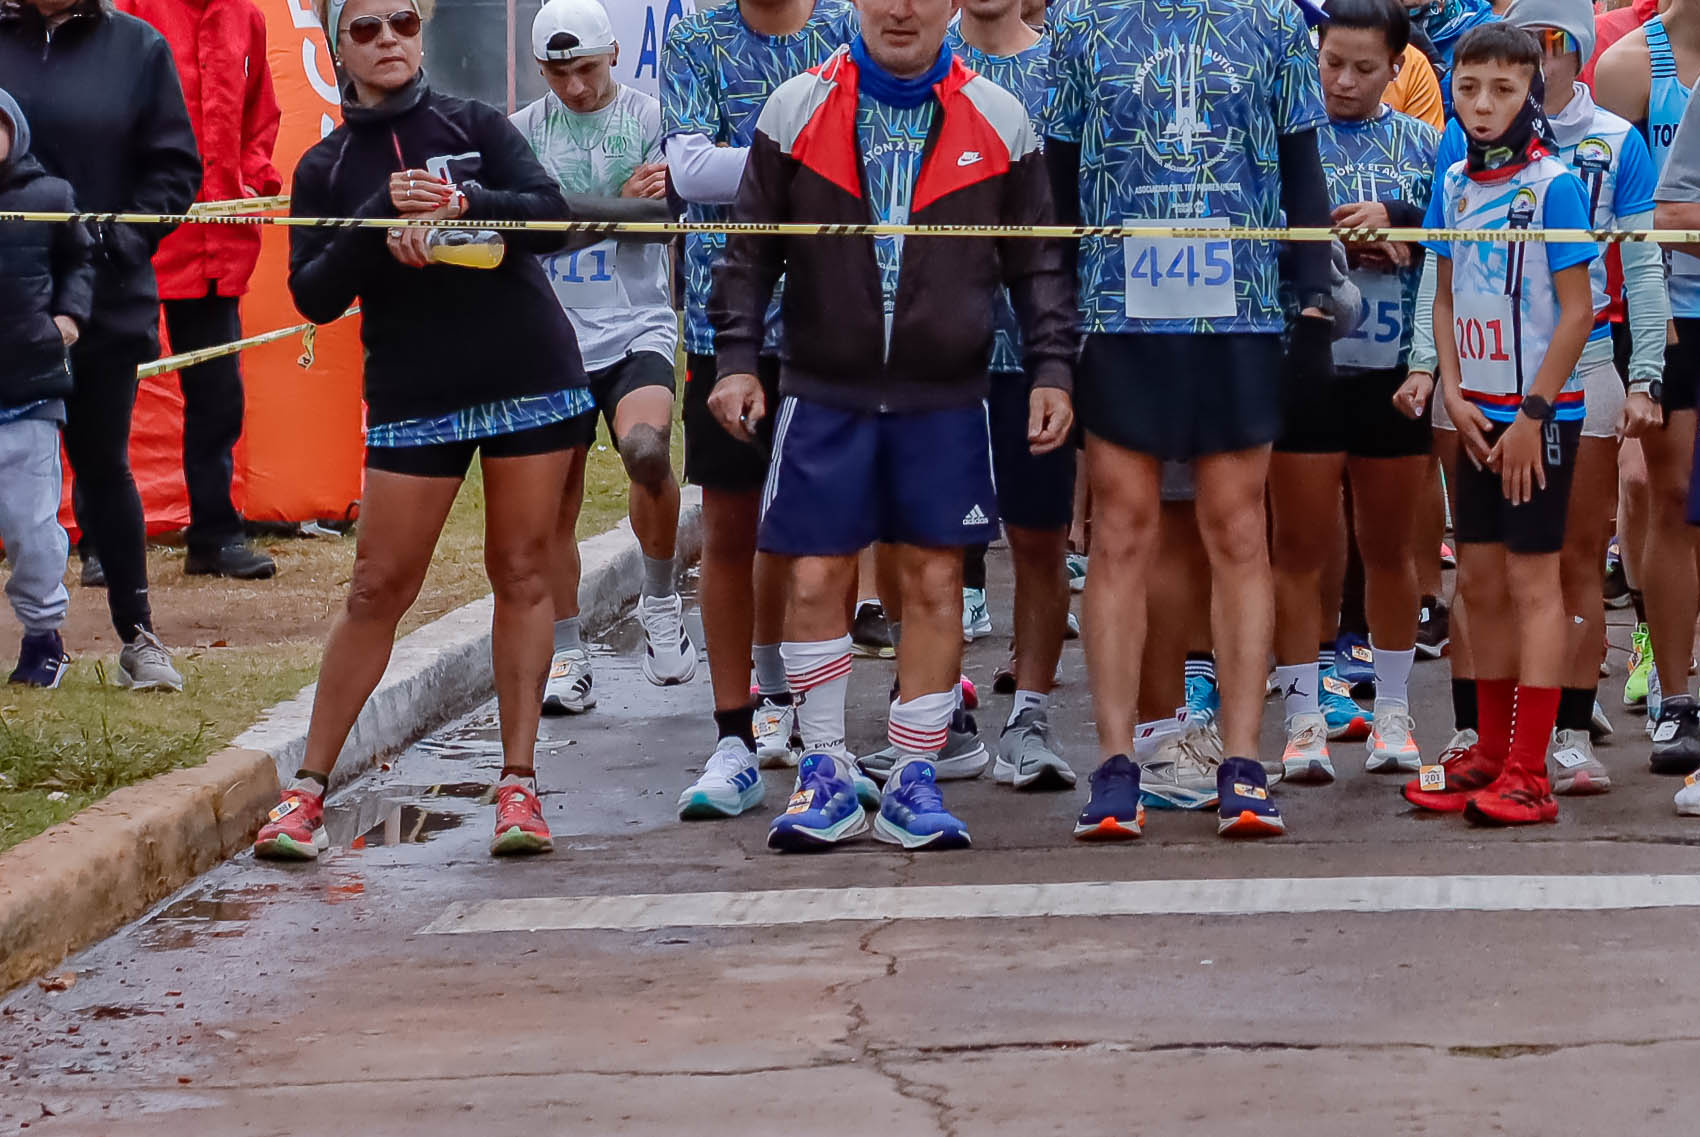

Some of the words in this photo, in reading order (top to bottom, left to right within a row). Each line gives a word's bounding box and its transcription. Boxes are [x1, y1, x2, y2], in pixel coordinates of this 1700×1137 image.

[1131, 242, 1232, 287] 445
[1350, 297, 1400, 343] 25
[1456, 317, 1510, 361] 201
[1424, 774, 1441, 785] 201
